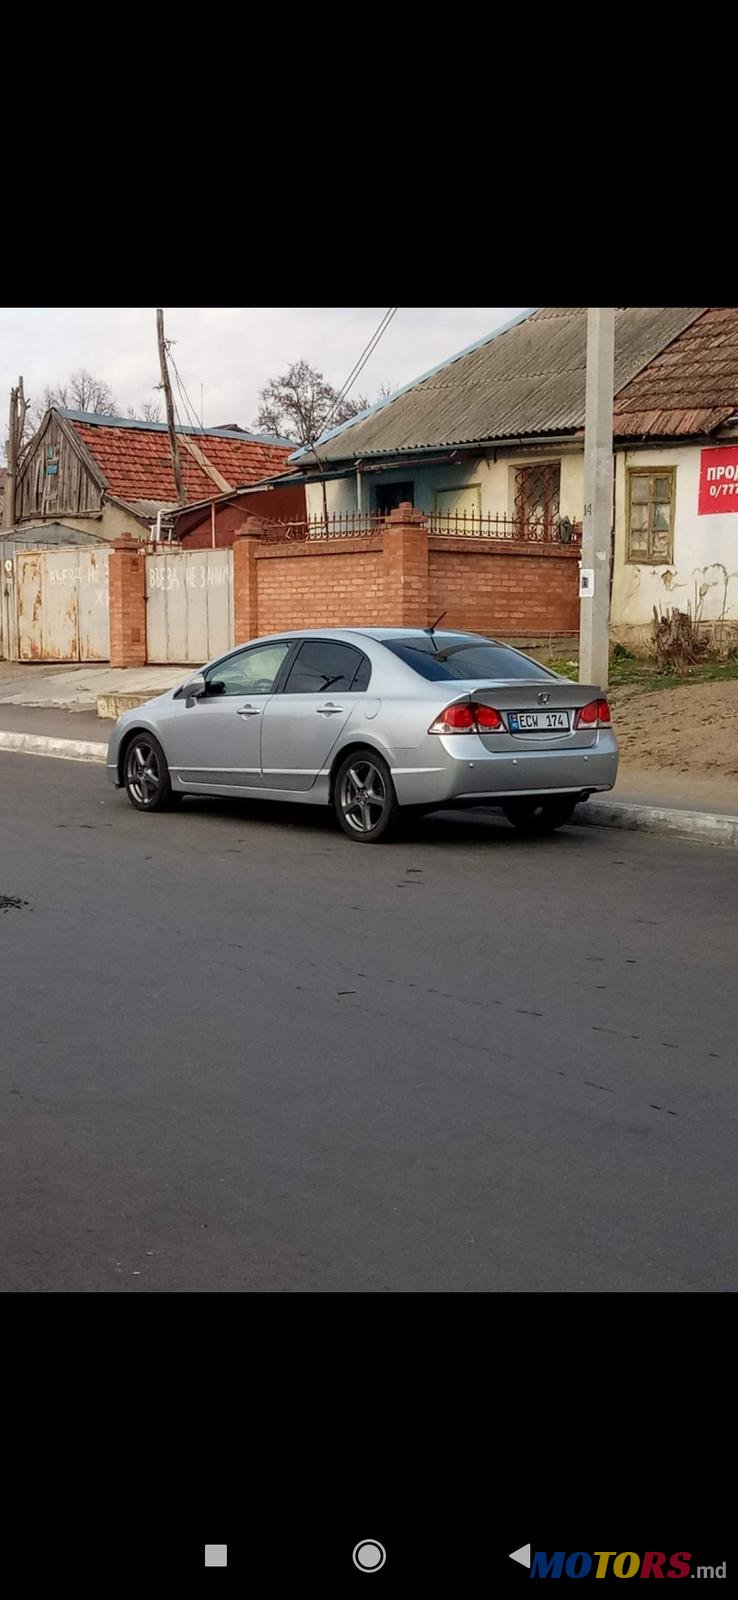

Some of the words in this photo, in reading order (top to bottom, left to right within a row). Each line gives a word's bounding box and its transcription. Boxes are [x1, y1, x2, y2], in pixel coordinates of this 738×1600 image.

[583, 503, 592, 516] 14
[519, 715, 539, 728] ECW
[546, 714, 563, 727] 174
